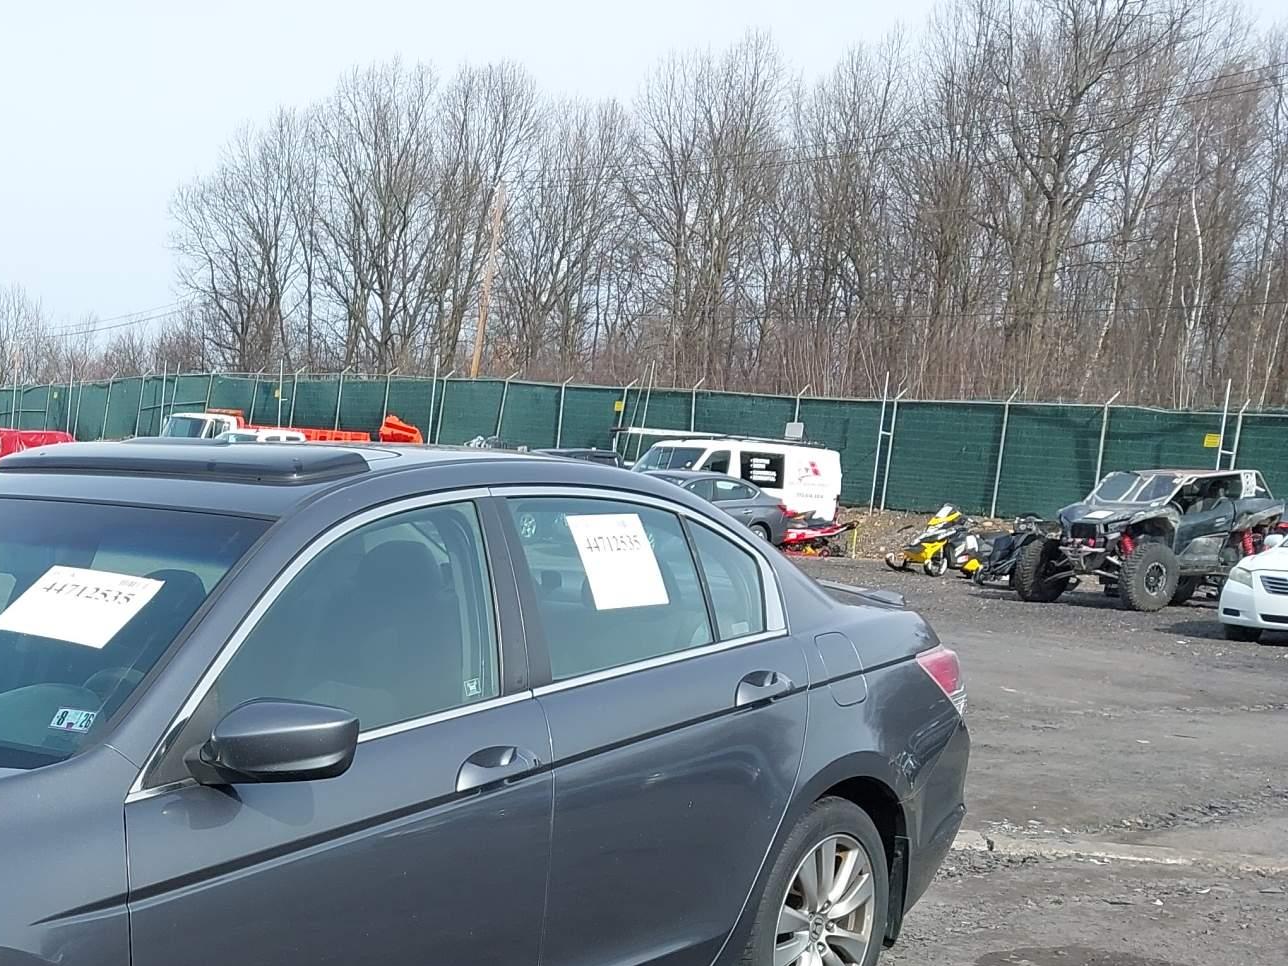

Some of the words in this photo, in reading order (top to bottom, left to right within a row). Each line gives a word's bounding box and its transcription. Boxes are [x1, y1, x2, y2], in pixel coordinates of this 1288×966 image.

[585, 535, 641, 552] 44712535
[43, 582, 135, 604] 44712535
[79, 712, 95, 728] 26
